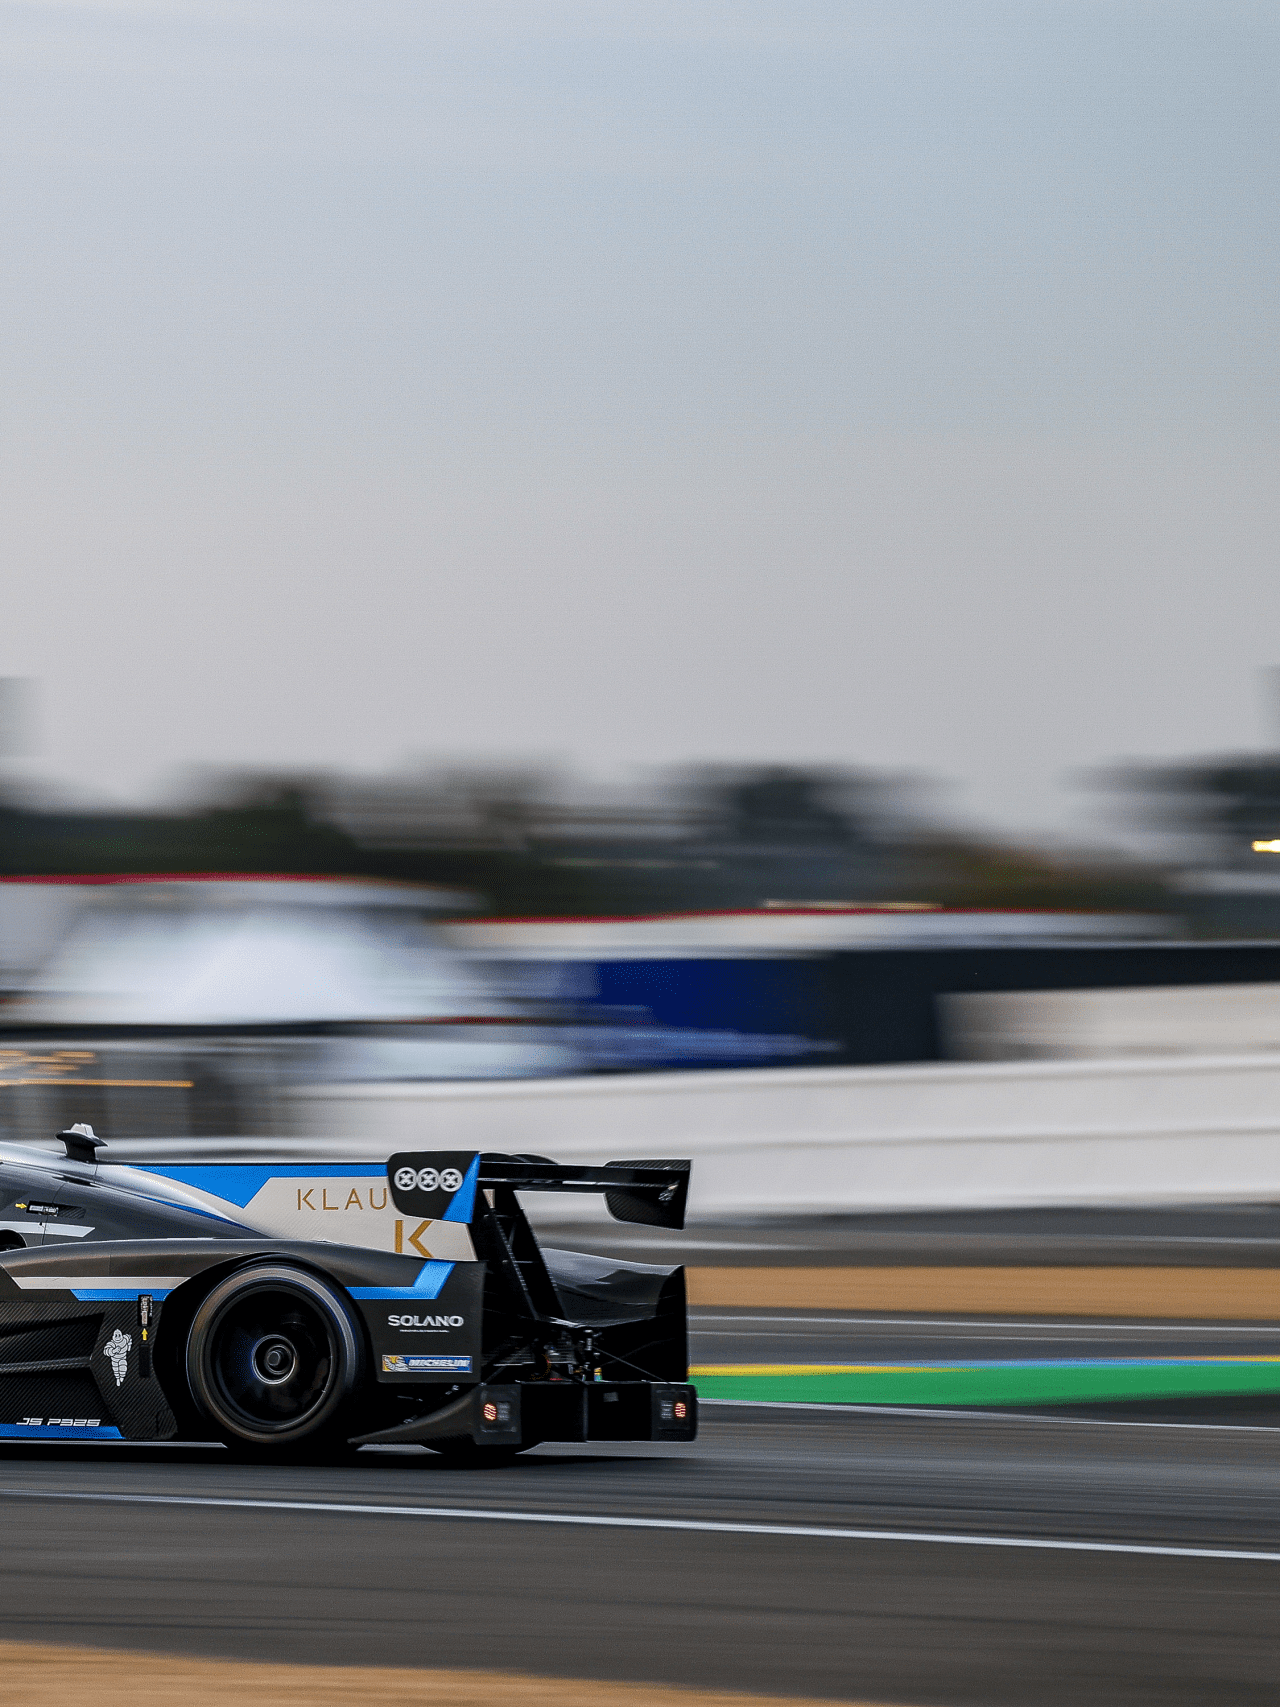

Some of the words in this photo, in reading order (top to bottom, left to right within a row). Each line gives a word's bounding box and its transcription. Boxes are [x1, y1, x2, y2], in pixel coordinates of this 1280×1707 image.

[395, 1220, 434, 1258] K
[388, 1315, 464, 1327] SOLANO
[408, 1359, 471, 1367] MICHELIN
[16, 1417, 43, 1426] JS
[46, 1418, 101, 1427] P325
